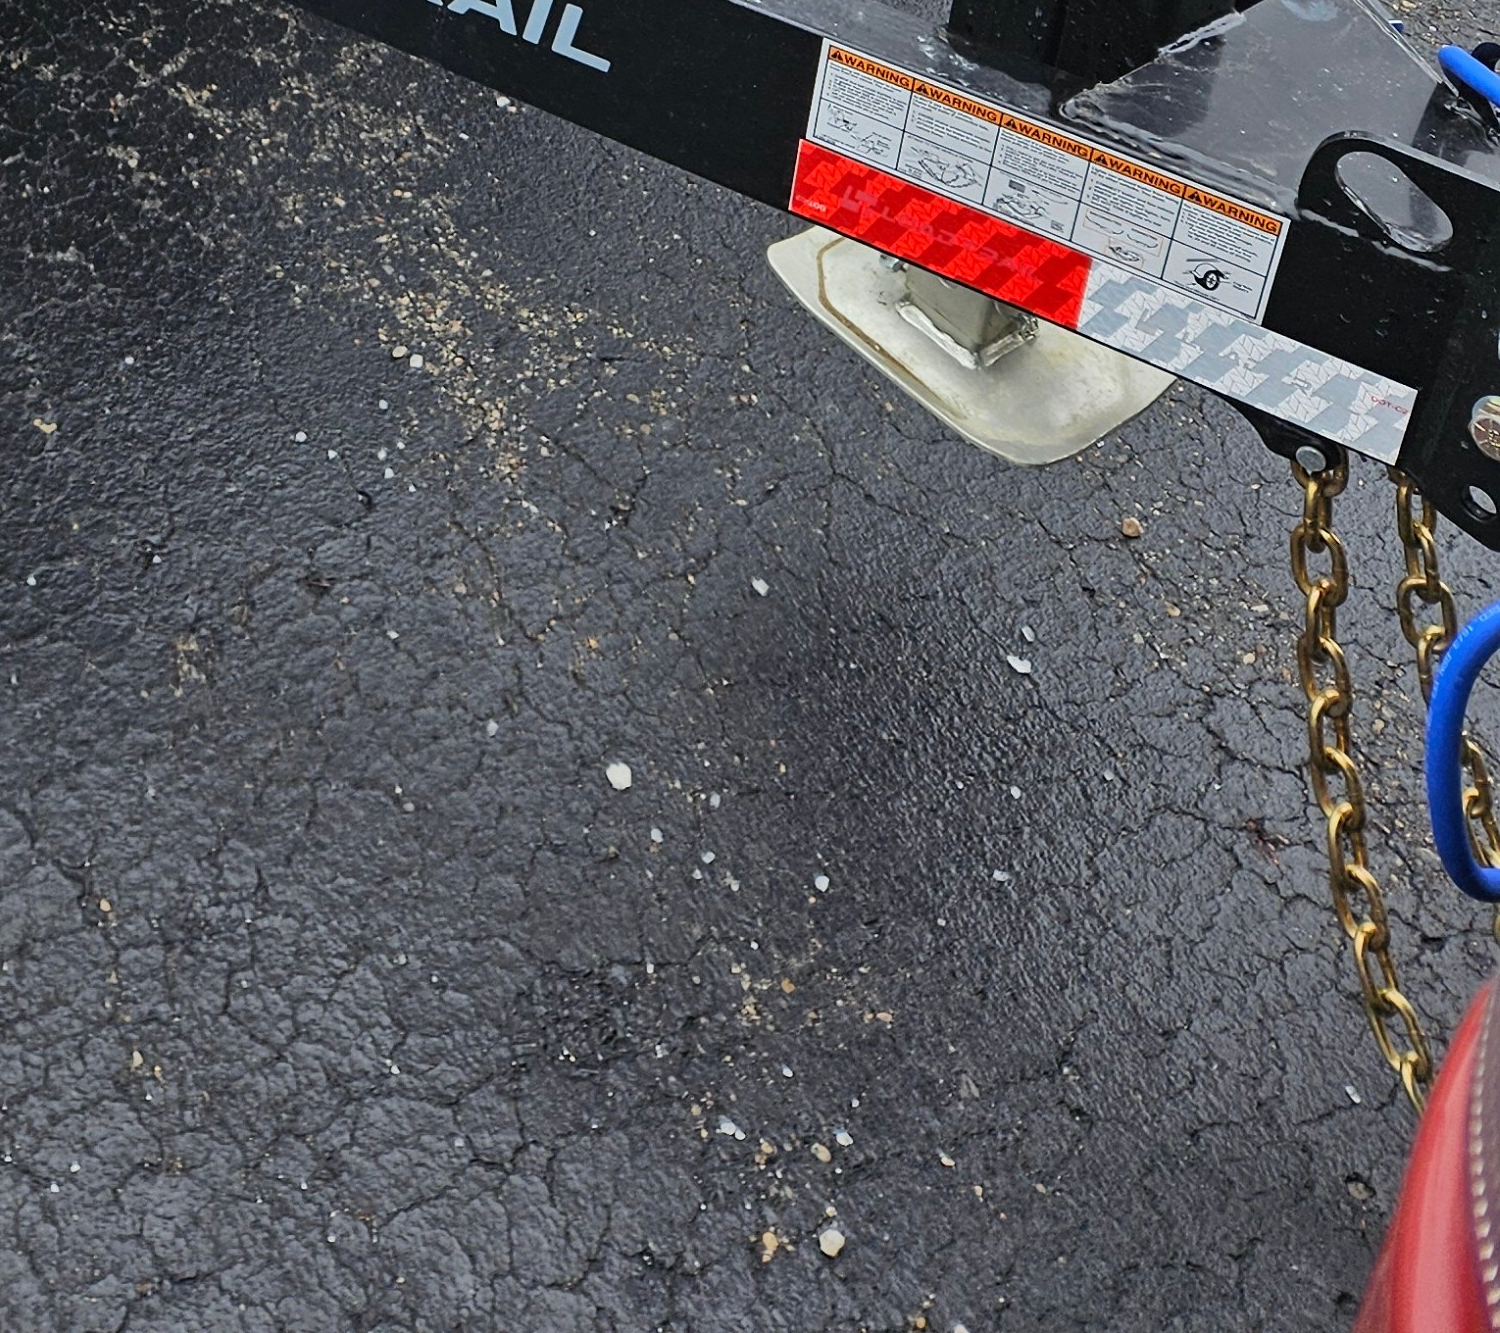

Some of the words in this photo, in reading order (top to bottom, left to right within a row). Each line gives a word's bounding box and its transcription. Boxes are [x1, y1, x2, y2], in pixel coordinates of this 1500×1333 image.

[844, 54, 910, 89] WARNING
[930, 87, 997, 122] WARNING
[1017, 121, 1088, 157] WARNING
[1110, 161, 1181, 195] WARNING
[1203, 199, 1278, 233] WARNING
